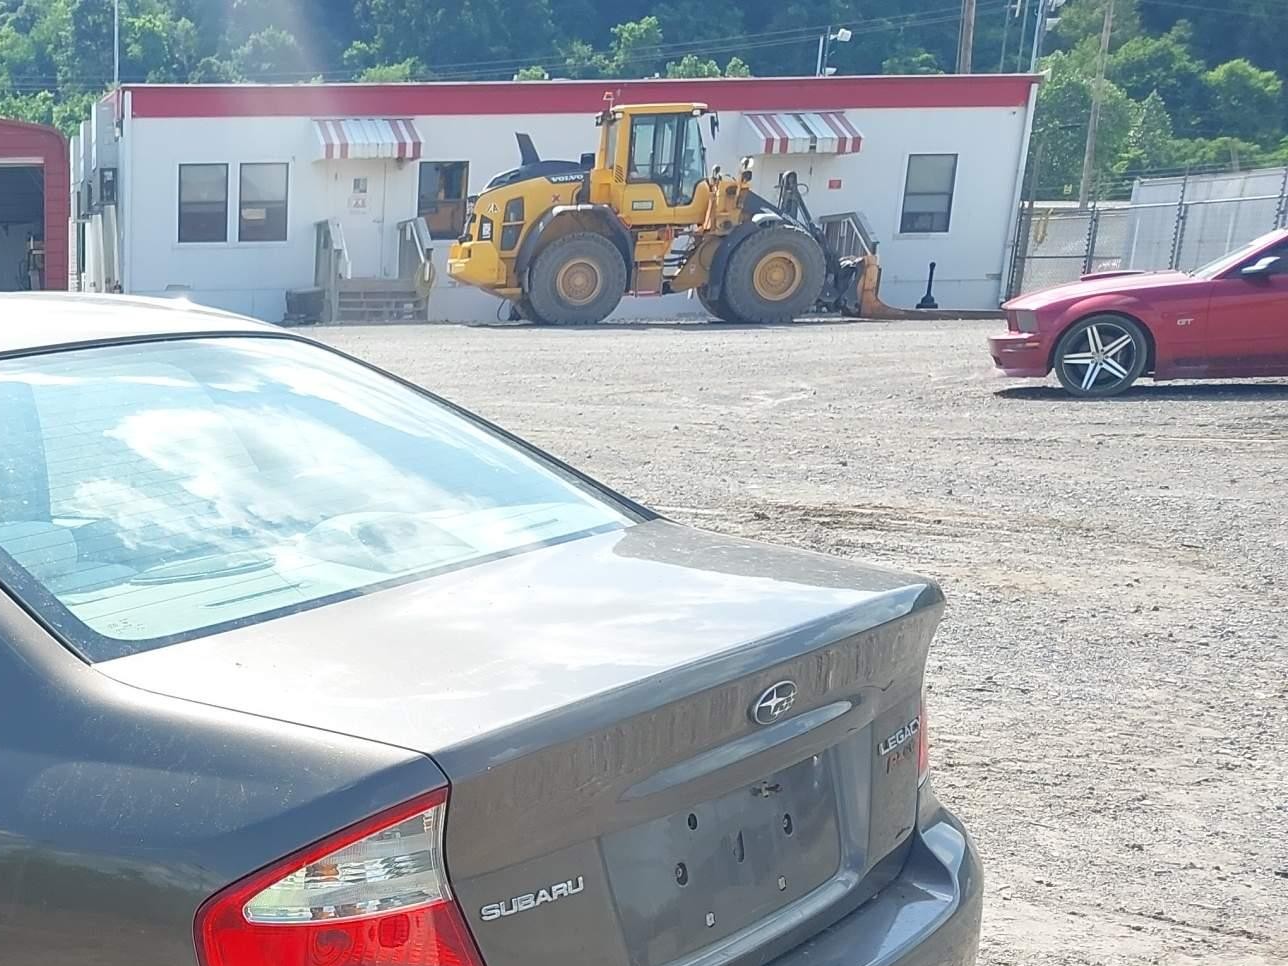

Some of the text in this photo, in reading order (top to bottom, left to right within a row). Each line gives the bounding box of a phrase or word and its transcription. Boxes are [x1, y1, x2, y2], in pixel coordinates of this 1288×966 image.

[551, 174, 584, 183] VOLVO
[1176, 318, 1195, 326] GT
[480, 875, 584, 921] SUBARU
